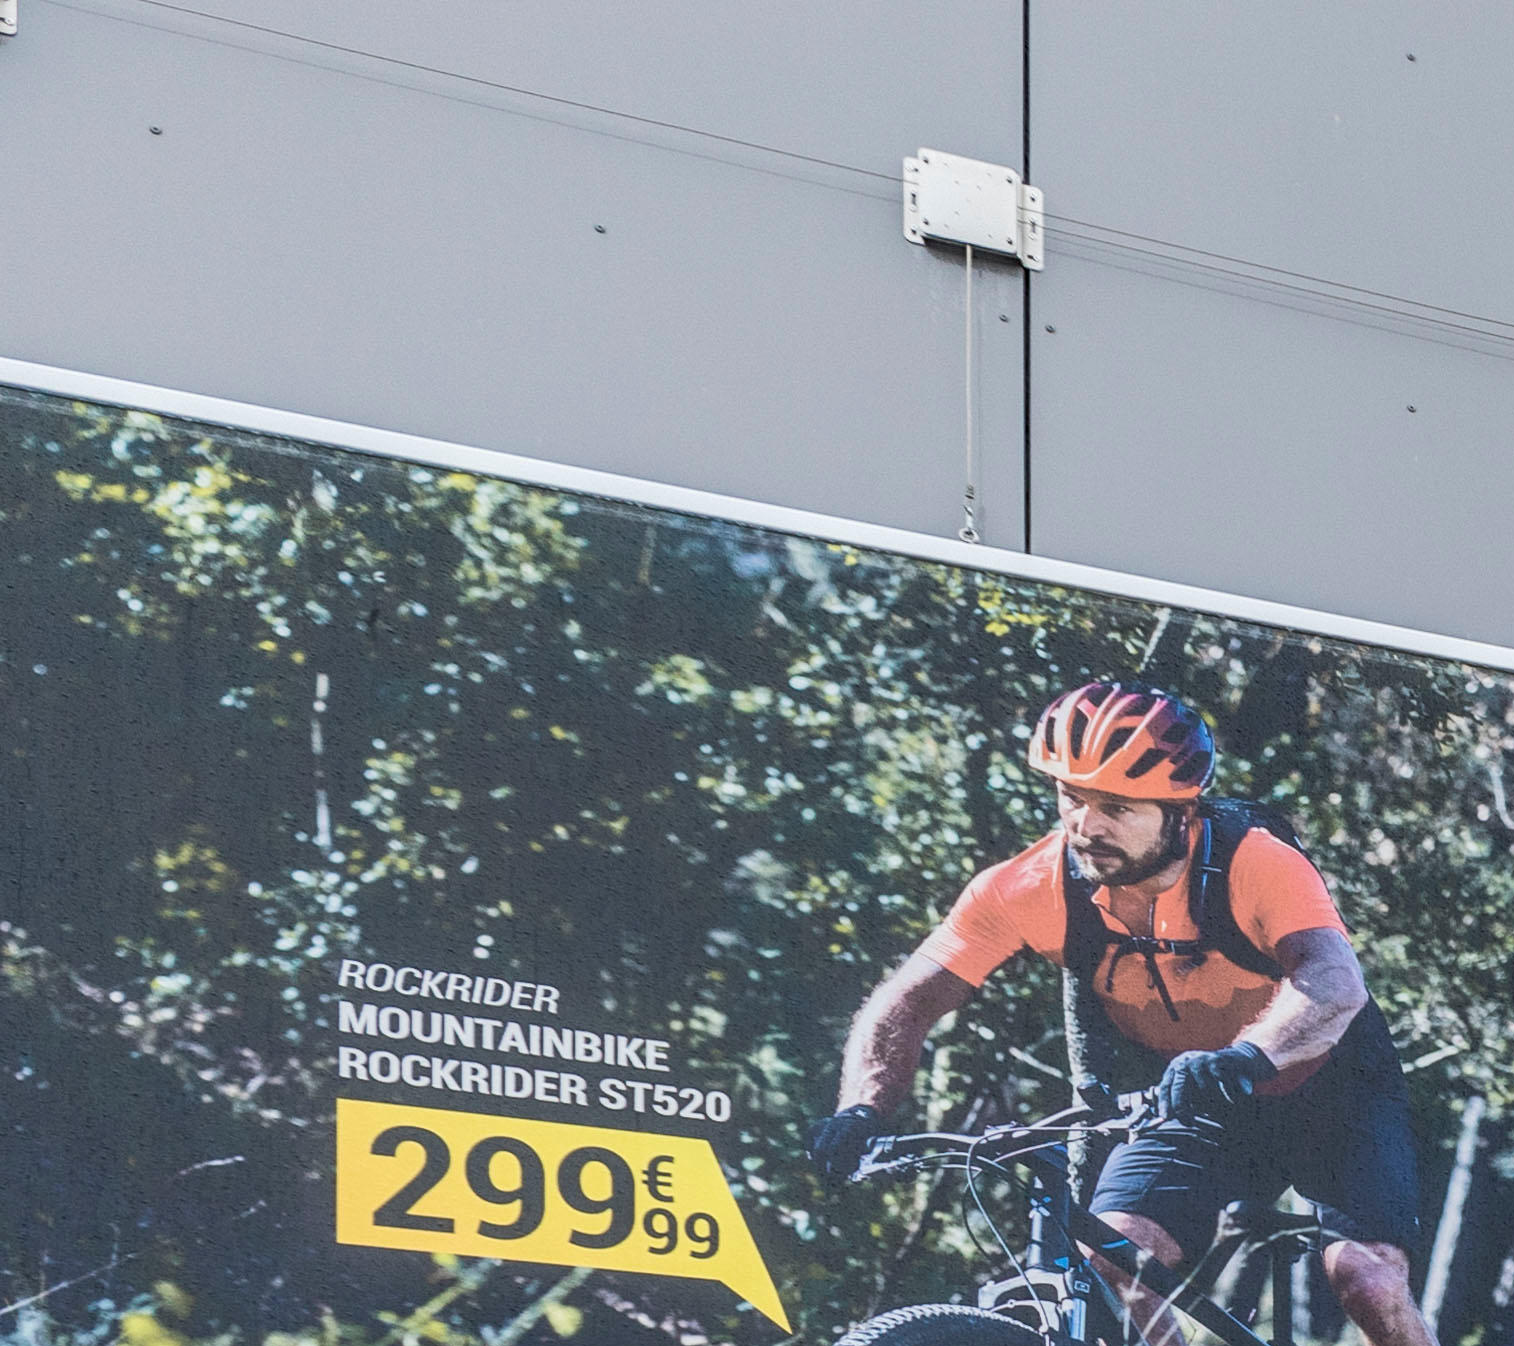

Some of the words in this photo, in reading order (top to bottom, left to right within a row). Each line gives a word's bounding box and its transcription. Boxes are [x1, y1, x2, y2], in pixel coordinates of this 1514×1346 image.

[338, 959, 560, 1014] ROCKRIDER
[338, 1000, 671, 1072] MOUNTAINBIKE
[338, 1046, 588, 1106] ROCKRIDER
[599, 1078, 731, 1122] ST520
[370, 1125, 637, 1250] 299
[642, 1154, 675, 1203] €
[643, 1208, 720, 1259] 99
